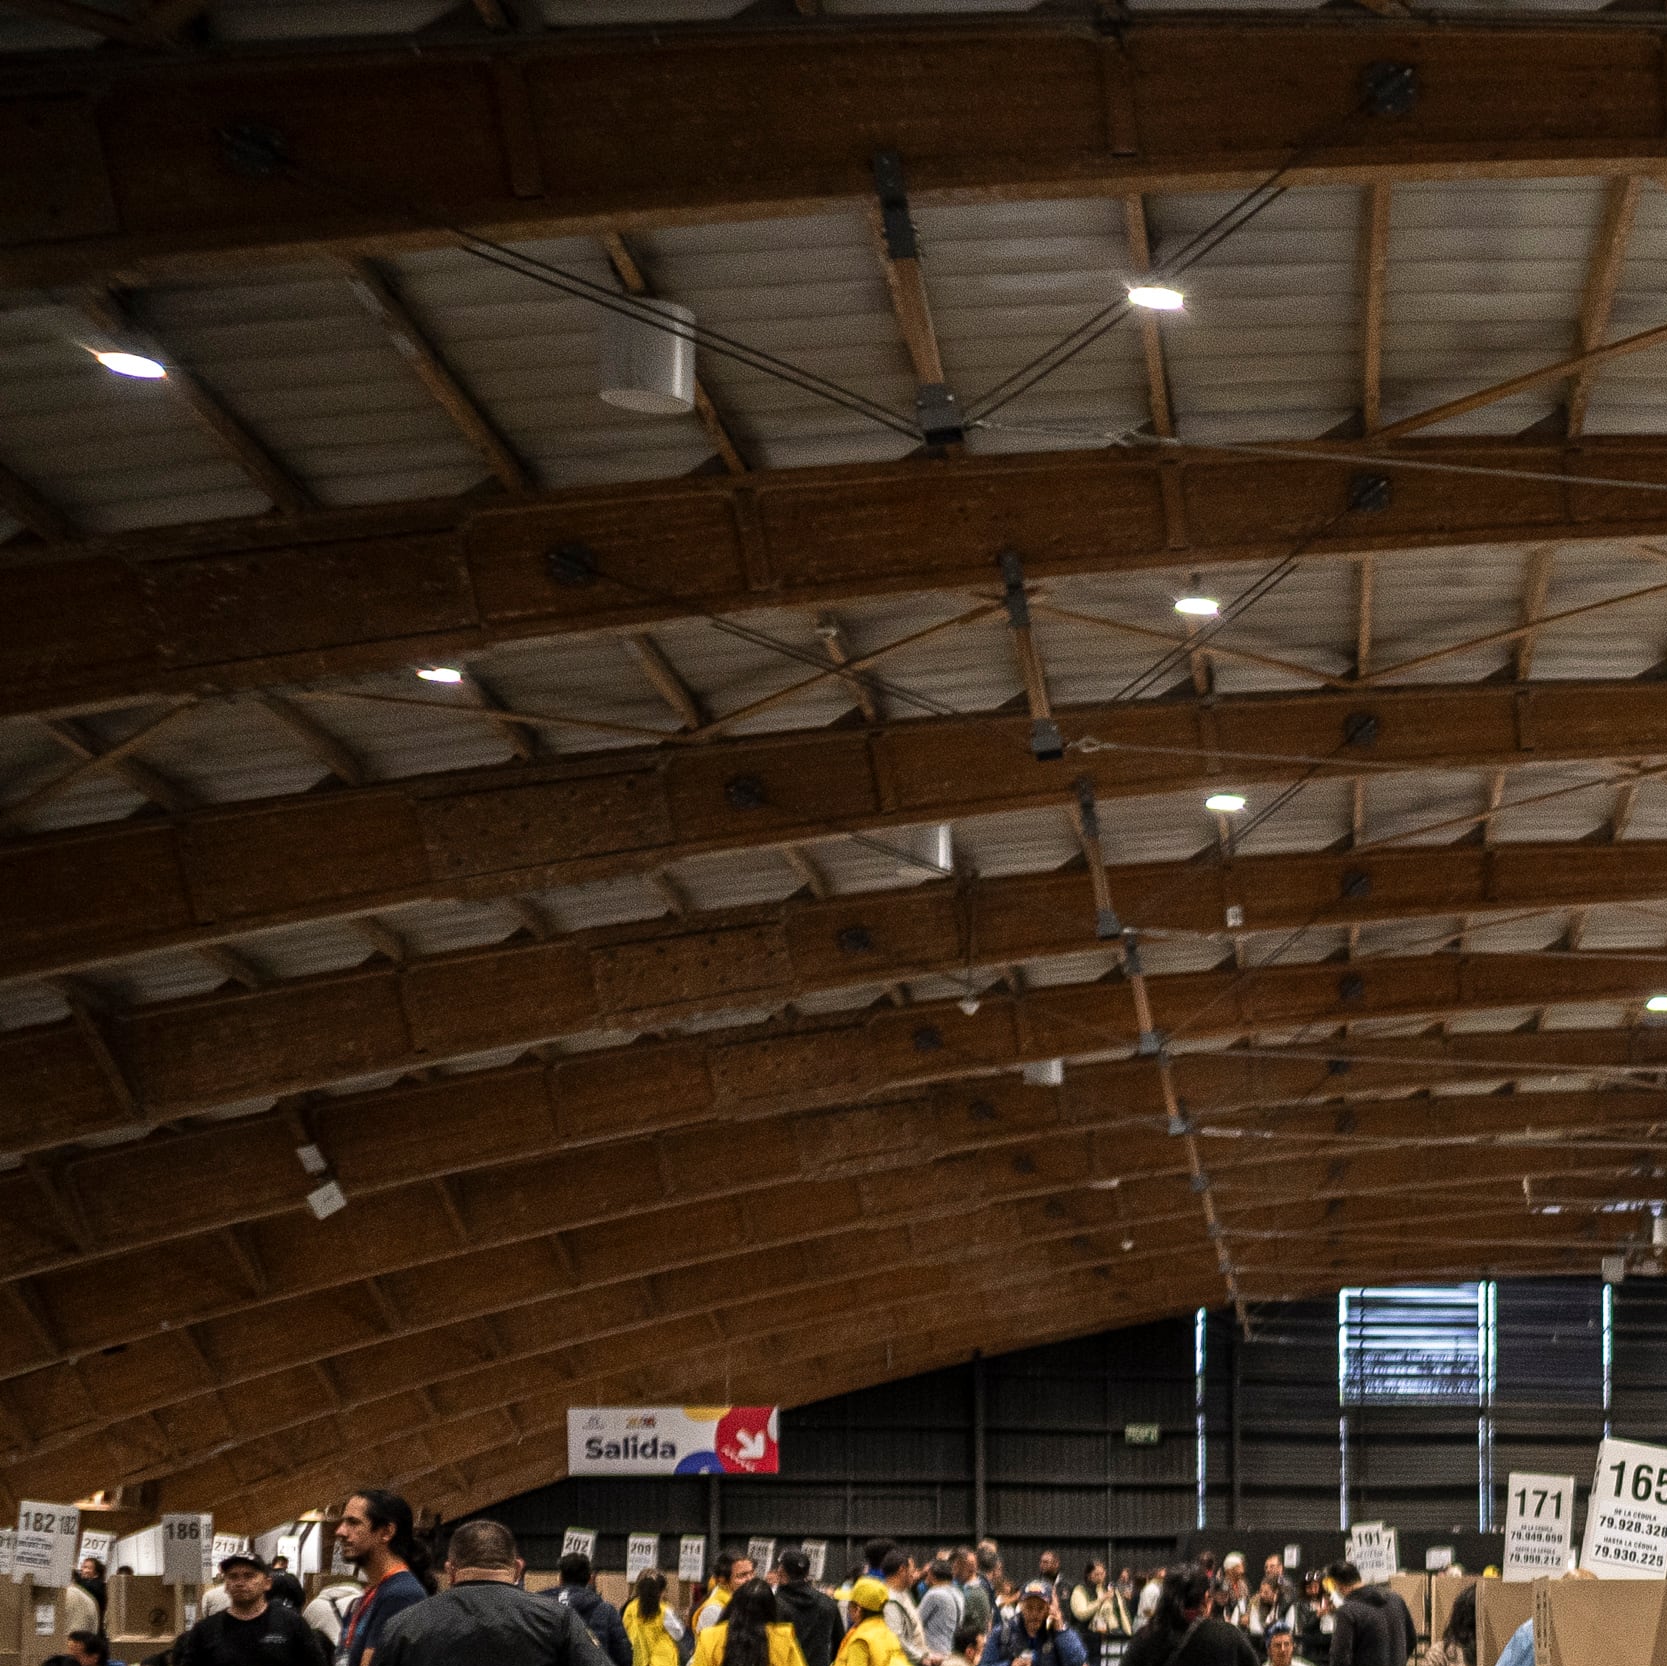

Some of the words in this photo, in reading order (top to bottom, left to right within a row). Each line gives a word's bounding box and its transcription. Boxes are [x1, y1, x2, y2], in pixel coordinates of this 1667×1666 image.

[585, 1435, 676, 1460] Salida
[1514, 1488, 1562, 1519] 171
[22, 1511, 55, 1533] 182
[166, 1523, 199, 1540] 186
[83, 1538, 107, 1551] 207
[567, 1536, 589, 1549] 202
